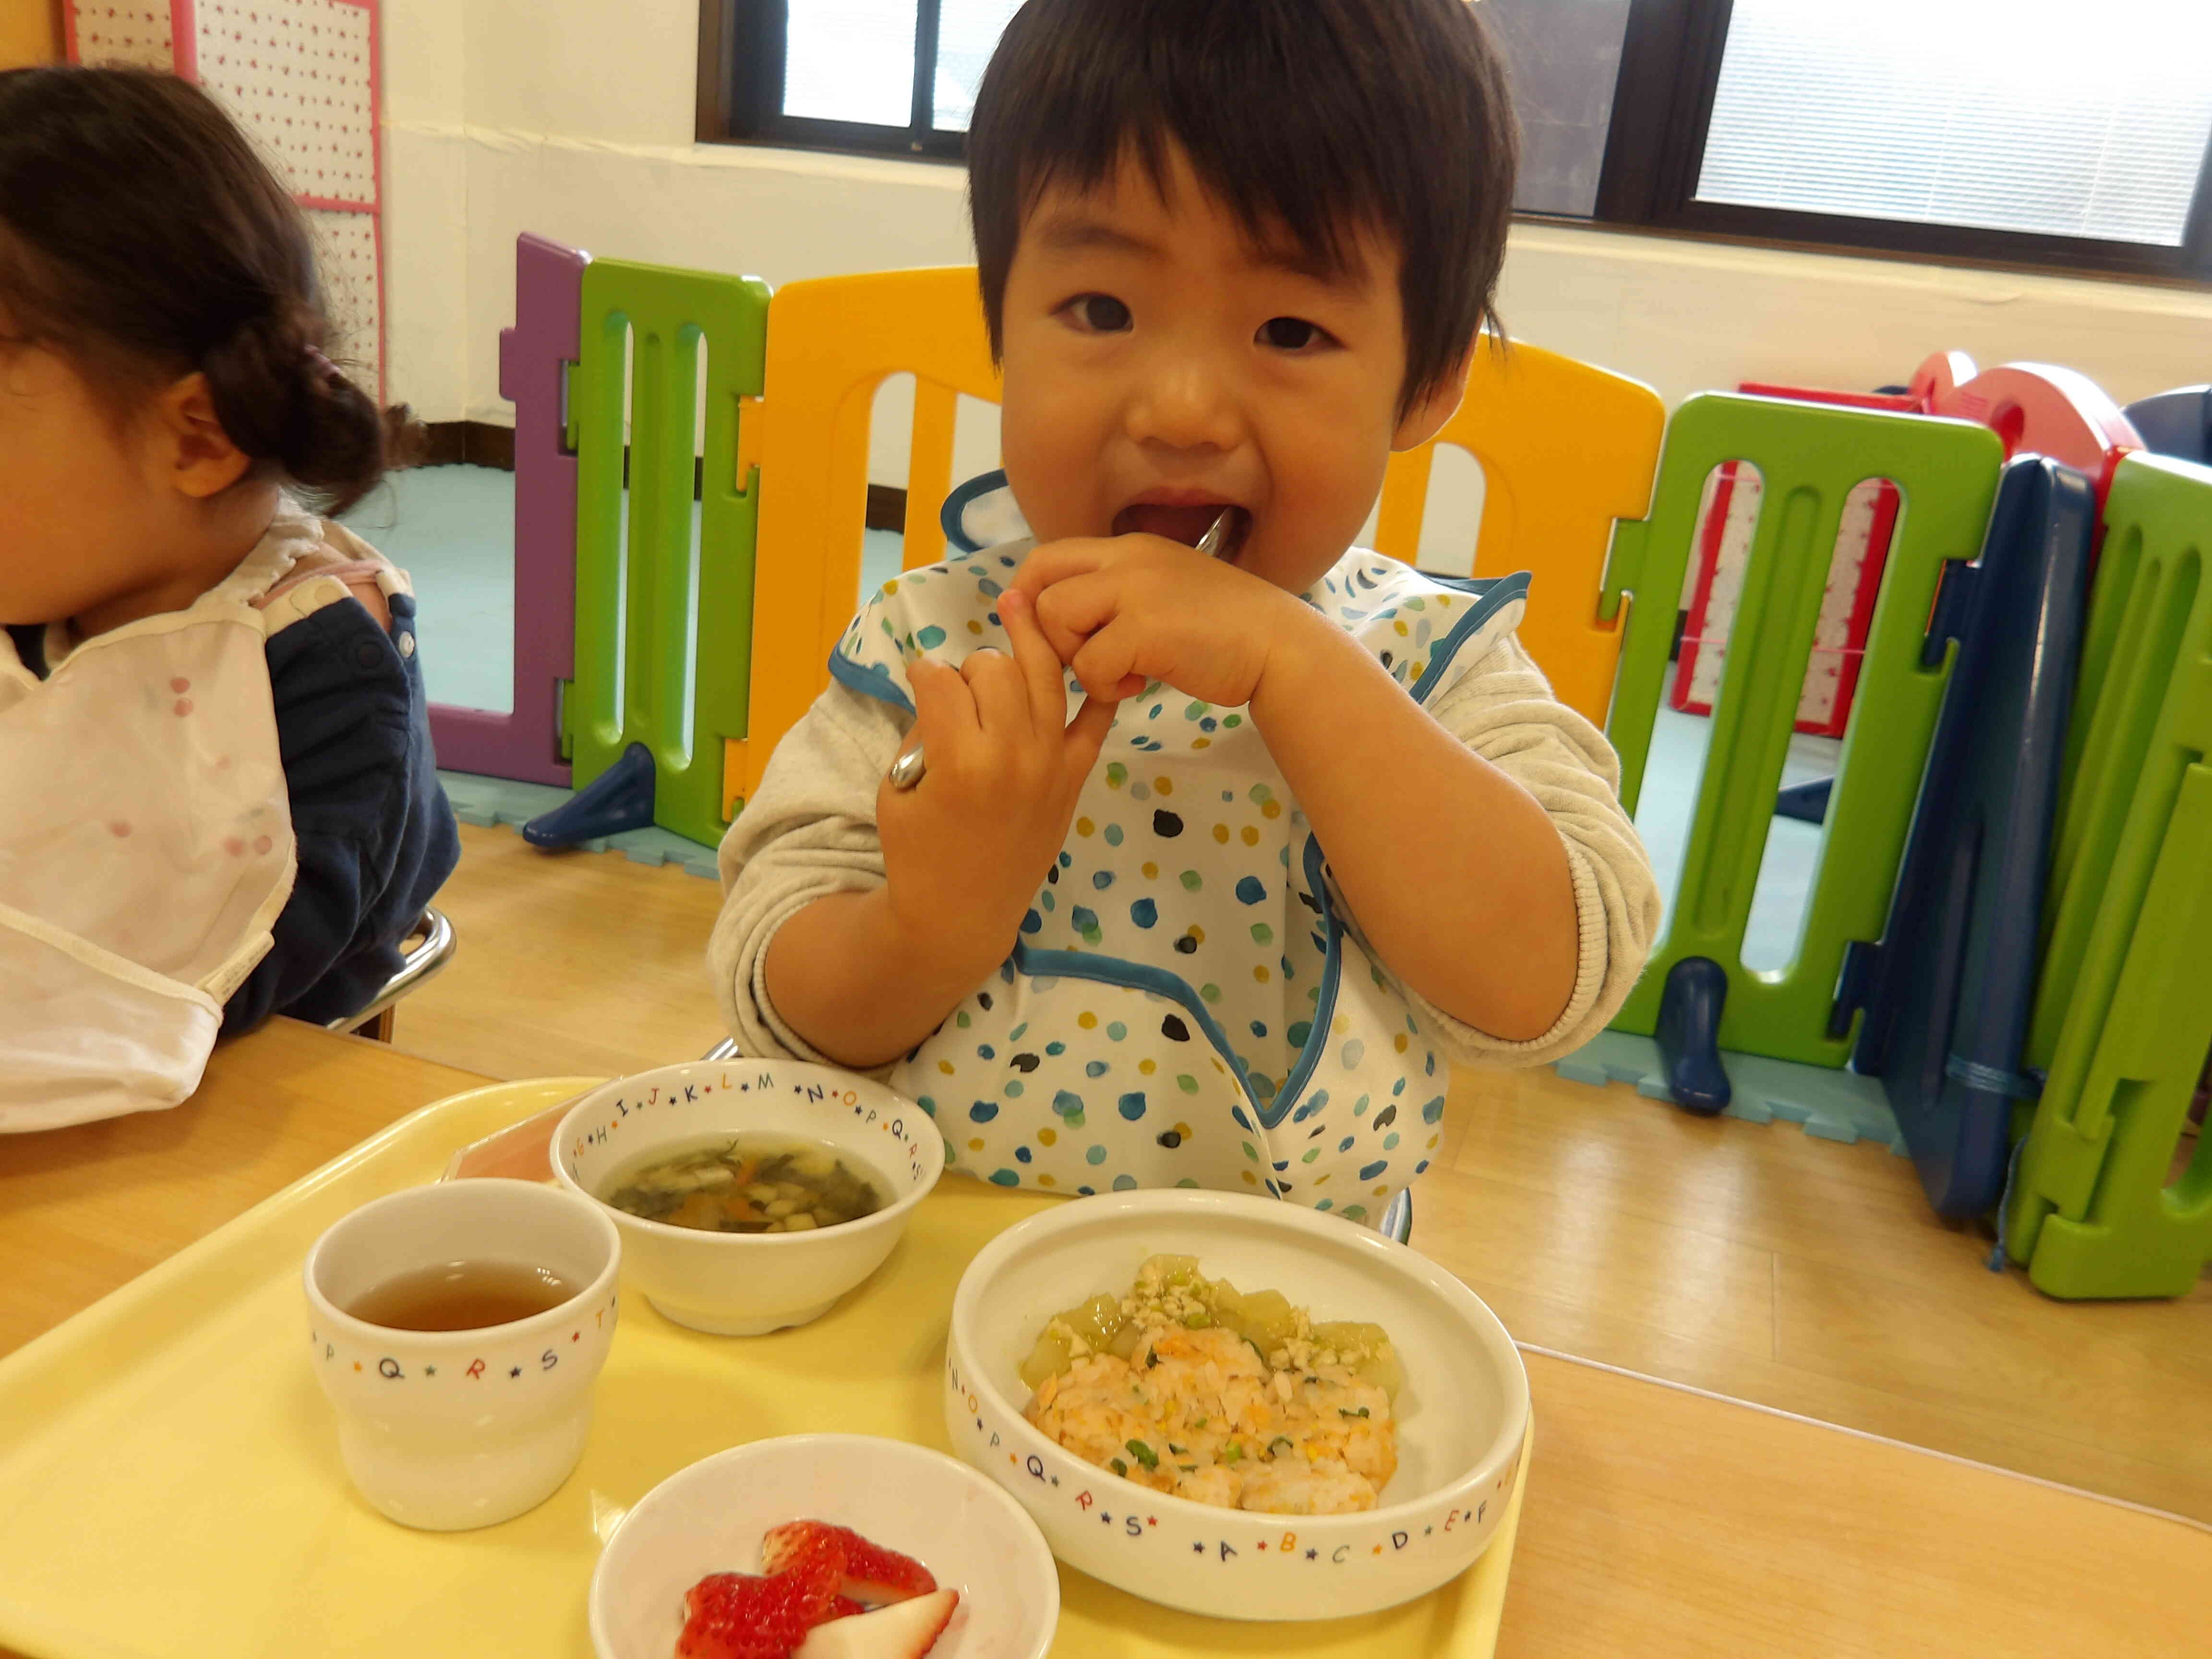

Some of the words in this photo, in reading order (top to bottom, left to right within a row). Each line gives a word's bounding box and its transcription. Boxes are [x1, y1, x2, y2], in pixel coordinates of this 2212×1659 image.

[597, 1125, 607, 1144] H
[616, 1098, 629, 1118] I
[649, 1087, 660, 1106] J
[685, 1084, 698, 1103] K
[721, 1072, 733, 1090] L
[757, 1072, 774, 1091] M
[807, 1083, 824, 1104] N
[843, 1091, 857, 1106] O
[866, 1109, 877, 1124] P
[891, 1118, 903, 1141] Q
[326, 1343, 335, 1361] P
[379, 1357, 406, 1380] Q
[465, 1358, 486, 1381] R
[541, 1348, 558, 1371] S
[596, 1308, 605, 1329] T
[951, 1367, 959, 1390] N
[968, 1394, 978, 1414] O
[989, 1431, 1000, 1448] P
[1026, 1454, 1046, 1483] Q
[1075, 1490, 1093, 1512] R
[1125, 1515, 1142, 1536] S
[1220, 1540, 1239, 1563] A
[1279, 1531, 1297, 1553] B
[1331, 1544, 1351, 1563] C
[1391, 1530, 1408, 1551] D
[1444, 1509, 1460, 1532] E
